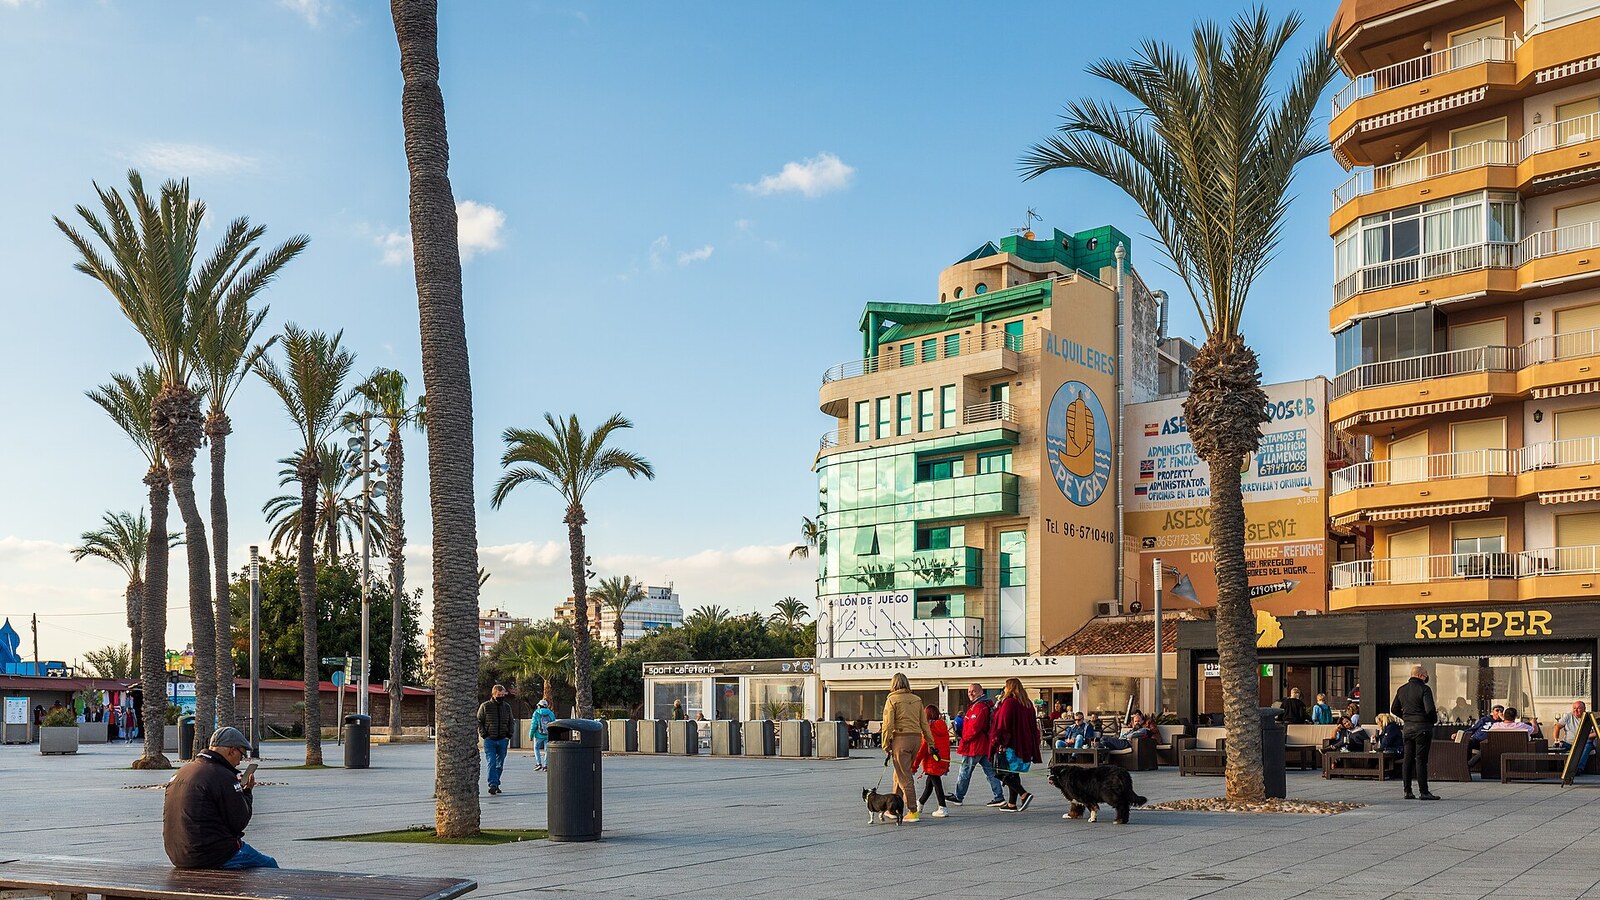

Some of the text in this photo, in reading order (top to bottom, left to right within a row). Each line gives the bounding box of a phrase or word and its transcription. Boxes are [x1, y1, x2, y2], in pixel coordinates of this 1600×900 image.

[1046, 333, 1114, 376] ALQUILERES
[1266, 400, 1294, 420] DOS
[1162, 416, 1190, 435] ASE
[1296, 430, 1306, 440] EN
[1148, 443, 1197, 457] ADMINISTRA
[1158, 455, 1200, 469] DE FINCAS
[1263, 450, 1306, 465] LLAMENOS
[1158, 469, 1194, 480] PROPERTY
[1056, 464, 1102, 502] PEYSA
[1149, 478, 1206, 491] ADMINISTRATOR
[1177, 491, 1186, 499] EN
[1188, 490, 1195, 498] EL
[1197, 488, 1210, 497] CEN
[1064, 522, 1113, 544] 96-5710418
[1191, 551, 1213, 563] CON
[834, 594, 909, 607] ALÓN DE JUEGO
[1415, 610, 1553, 639] KEEPER
[649, 665, 672, 675] sport
[840, 657, 1058, 671] HOMBRE DEL MAR
